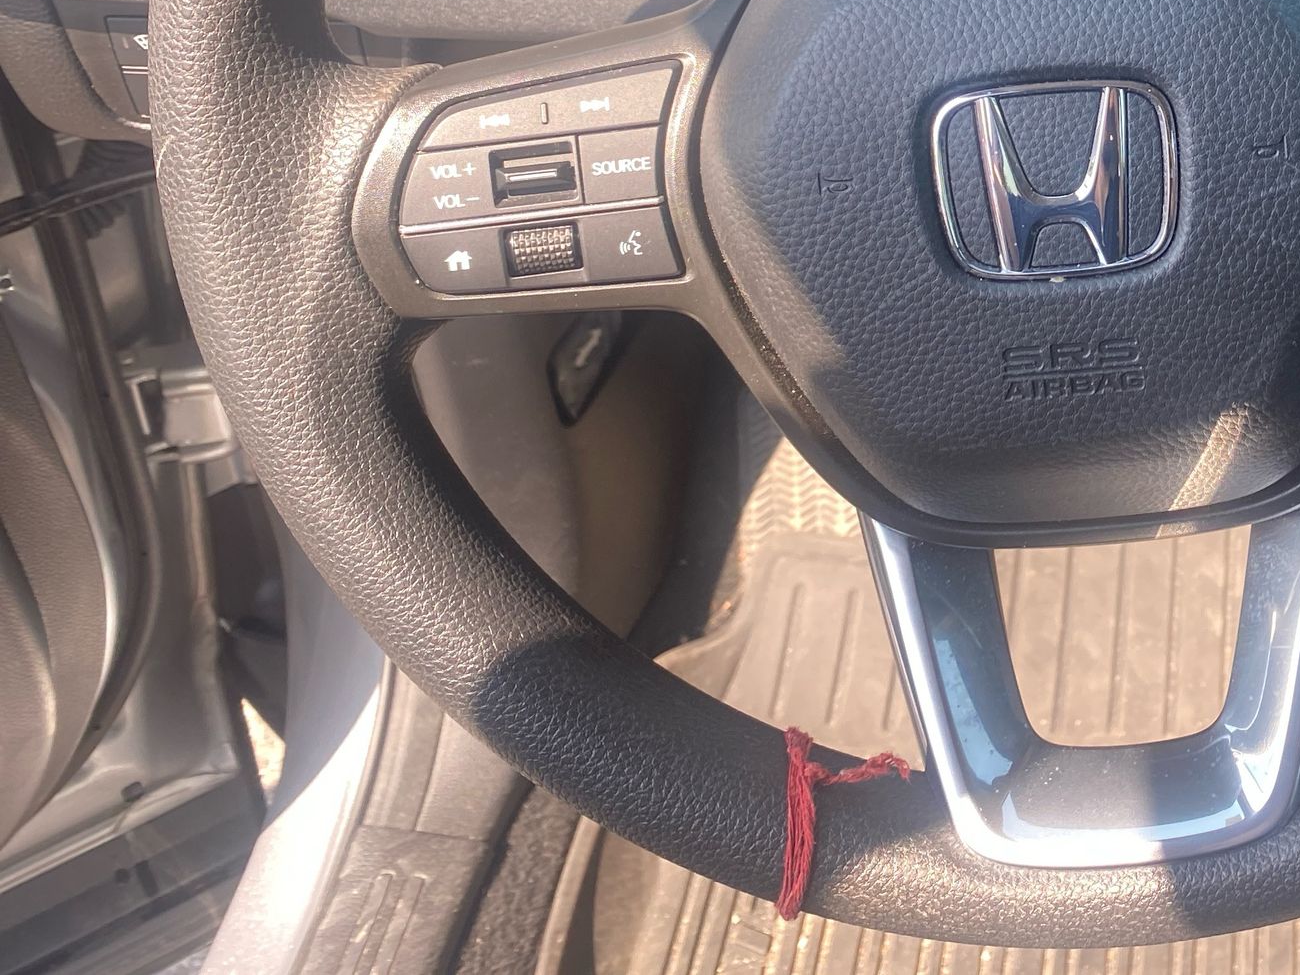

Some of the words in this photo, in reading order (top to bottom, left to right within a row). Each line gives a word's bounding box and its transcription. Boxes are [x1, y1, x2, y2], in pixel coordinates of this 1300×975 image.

[591, 156, 651, 176] SOURCE
[1003, 337, 1140, 374] SRS
[1004, 372, 1146, 402] AIRBAG
